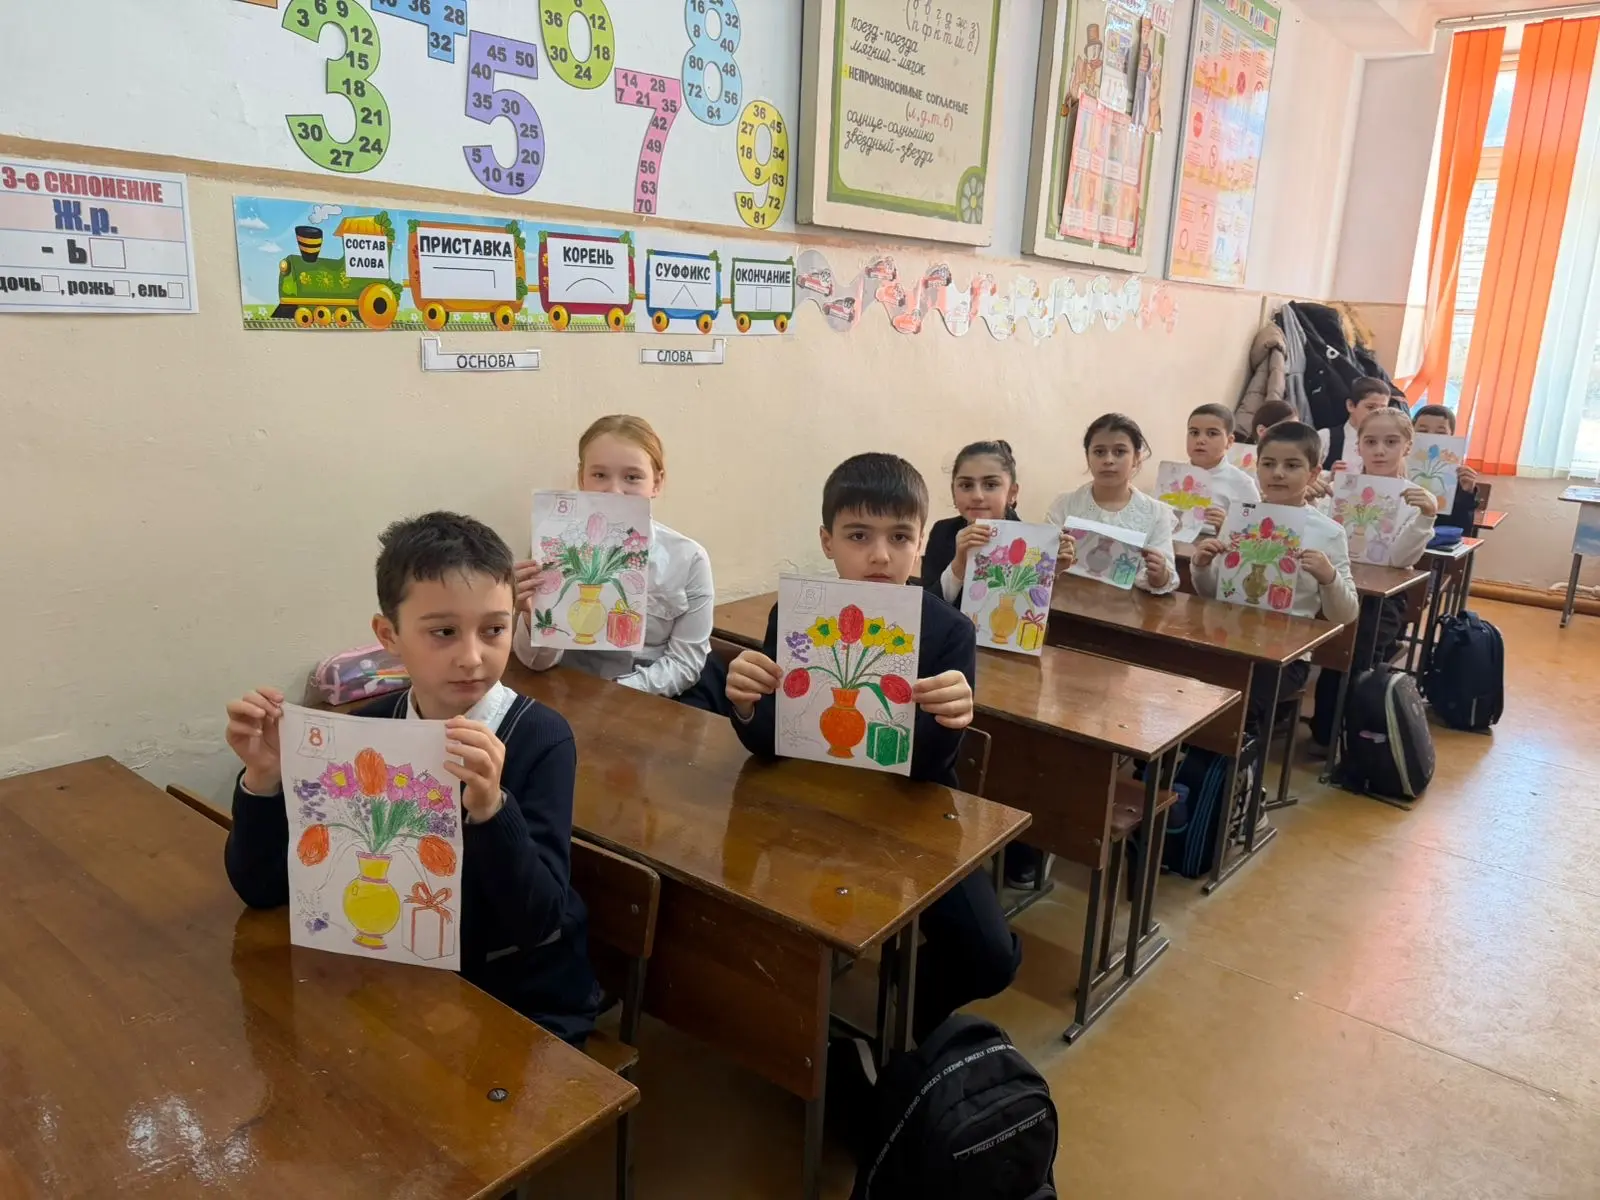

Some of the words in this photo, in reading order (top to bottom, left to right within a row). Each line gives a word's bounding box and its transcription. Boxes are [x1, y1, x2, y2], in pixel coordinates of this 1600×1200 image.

[314, 0, 328, 15] 6
[336, 0, 349, 18] 9
[443, 5, 465, 25] 28
[690, 0, 705, 14] 16
[296, 8, 310, 27] 3
[544, 10, 563, 28] 36
[589, 13, 606, 31] 12
[724, 12, 739, 29] 32
[351, 25, 374, 46] 12
[693, 24, 701, 38] 8
[430, 31, 452, 52] 32
[720, 38, 734, 53] 40
[345, 50, 369, 70] 15
[486, 44, 507, 62] 45
[515, 50, 535, 68] 50
[550, 45, 568, 63] 30
[594, 44, 610, 61] 18
[471, 62, 491, 80] 40
[689, 55, 704, 71] 80
[722, 62, 736, 77] 48
[574, 64, 592, 81] 24
[342, 78, 366, 98] 18
[622, 72, 638, 88] 14
[650, 78, 666, 93] 28
[849, 66, 922, 100] НЕПРОИЗНОСИМЫЕ
[926, 92, 969, 115] СОГЛАСНЫЕ
[688, 83, 702, 99] 72
[724, 90, 738, 105] 56
[472, 92, 492, 110] 35
[501, 98, 520, 115] 30
[617, 88, 625, 101] 7
[635, 90, 650, 106] 21
[661, 98, 677, 113] 35
[360, 107, 383, 126] 21
[753, 104, 766, 120] 36
[520, 123, 539, 139] 25
[651, 116, 667, 130] 42
[741, 121, 754, 136] 27
[770, 119, 782, 134] 45
[297, 122, 323, 142] 30
[359, 136, 383, 155] 24
[646, 139, 661, 153] 49
[740, 145, 753, 160] 18
[329, 149, 354, 167] 27
[472, 148, 482, 164] 5
[521, 149, 540, 165] 20
[772, 147, 785, 161] 54
[640, 161, 656, 174] 56
[754, 167, 761, 180] 9
[2, 166, 40, 191] 3-е
[44, 171, 163, 203] СКЛОНЕНИЕ
[482, 166, 501, 183] 10
[505, 171, 525, 187] 15
[772, 173, 784, 187] 63
[640, 180, 656, 195] 63
[636, 199, 652, 212] 70
[740, 195, 753, 210] 90
[768, 196, 781, 210] 72
[753, 211, 766, 225] 81
[345, 238, 386, 251] СОСТАВ
[420, 235, 513, 258] ПРИСТАВКА
[349, 257, 385, 269] СЛОВА
[562, 246, 614, 266] КОРЕНЬ
[655, 262, 711, 281] СУФФИКС
[735, 267, 791, 284] ОКОНЧАНИЕ
[456, 354, 516, 369] ОСНОВА
[656, 350, 694, 363] СЛОВА
[557, 500, 568, 513] 8
[309, 727, 323, 746] 8
